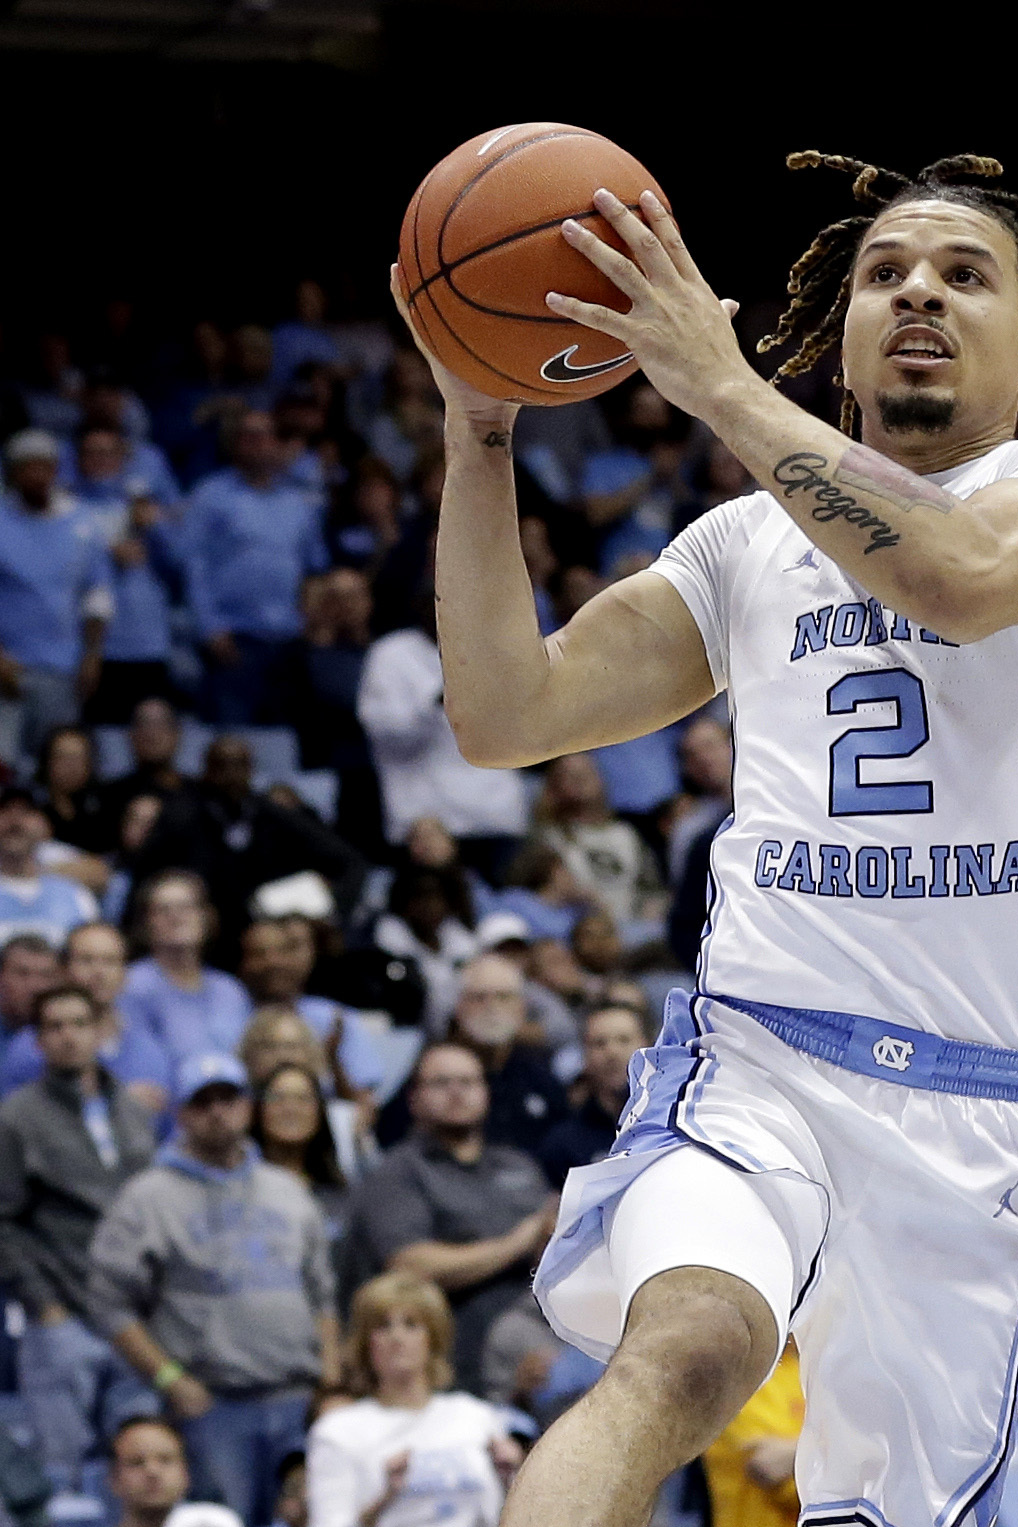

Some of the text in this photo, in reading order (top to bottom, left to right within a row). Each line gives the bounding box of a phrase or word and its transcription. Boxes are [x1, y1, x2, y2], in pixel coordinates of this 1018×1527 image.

[773, 452, 900, 555] Gregory
[790, 596, 960, 662] NOR
[826, 667, 934, 817] 2
